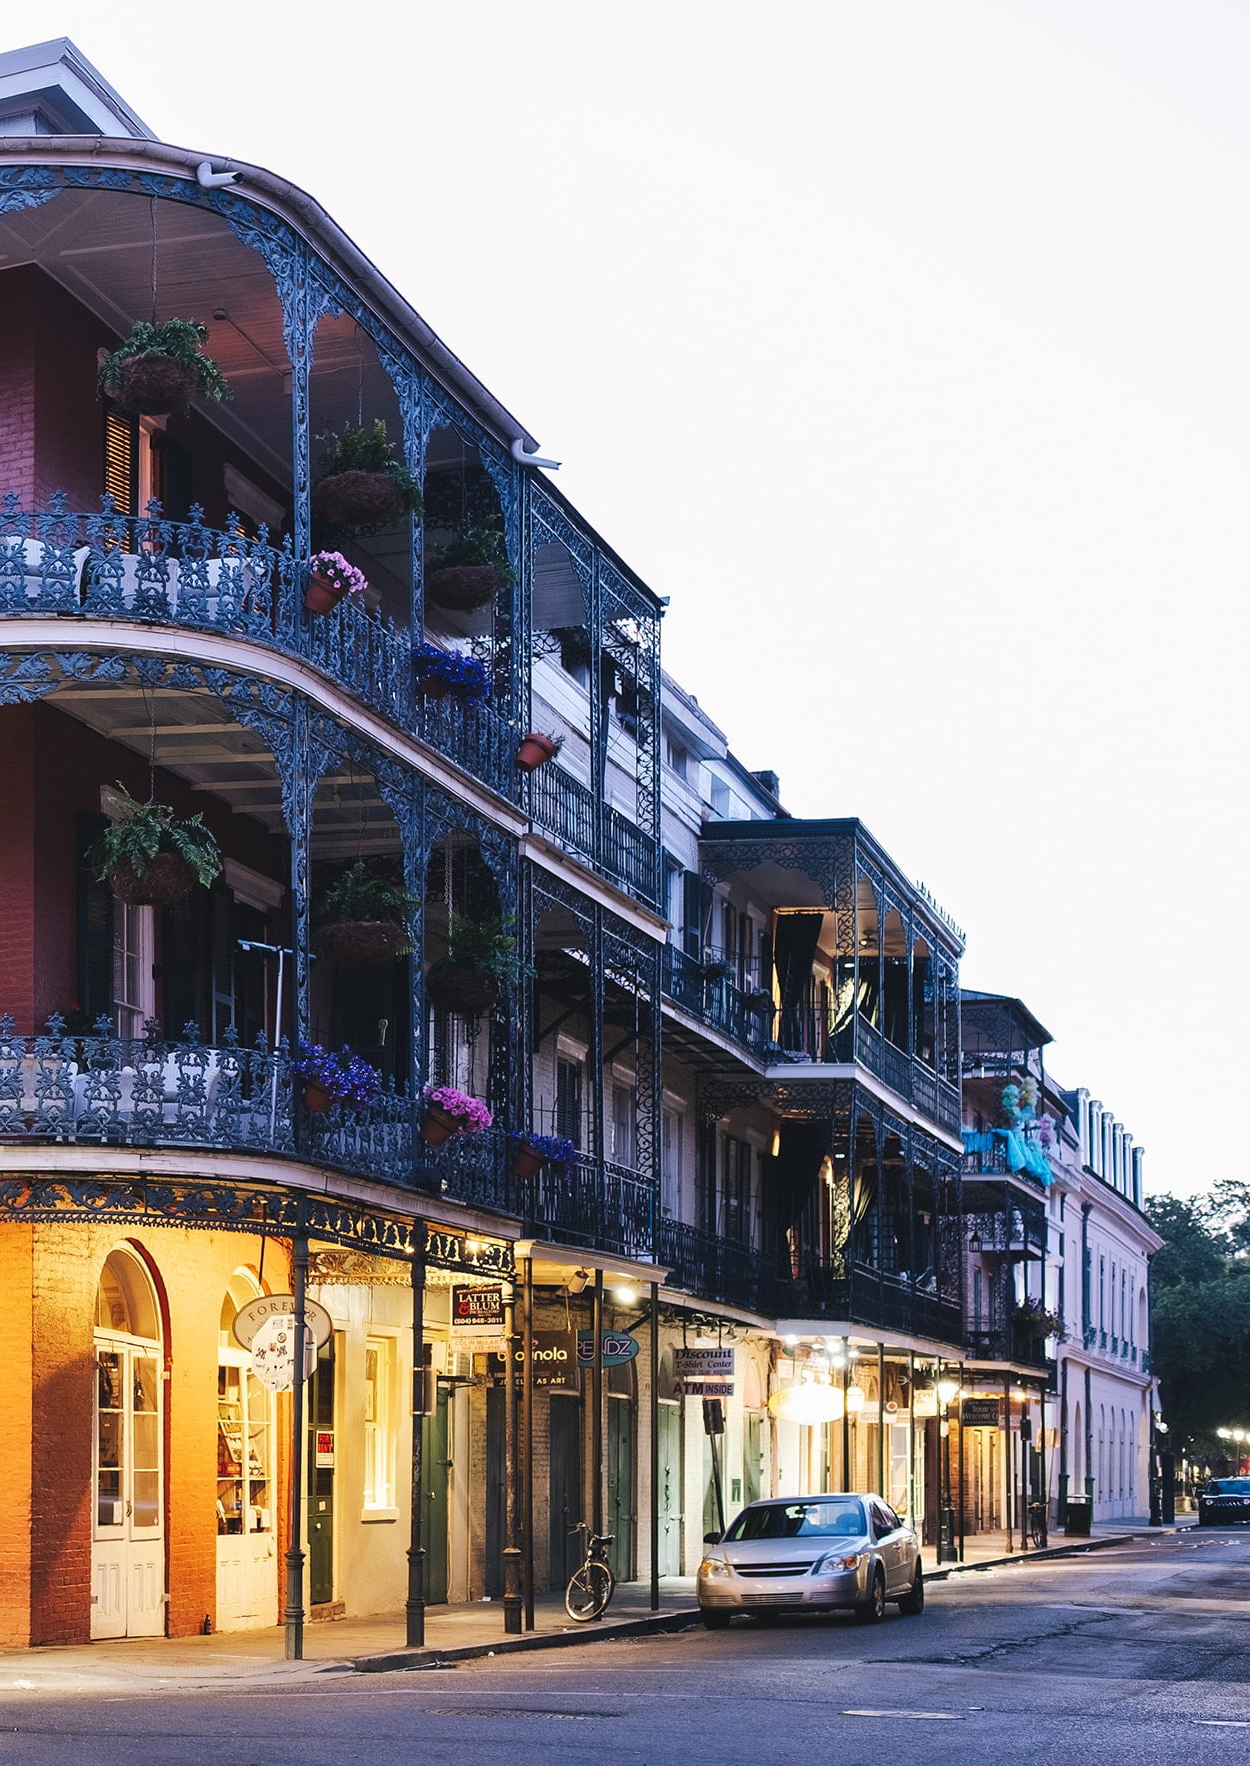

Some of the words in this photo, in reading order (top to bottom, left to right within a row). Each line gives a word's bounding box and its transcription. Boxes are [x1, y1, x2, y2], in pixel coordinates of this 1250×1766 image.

[459, 1293, 500, 1303] LATTER
[458, 1302, 470, 1316] &
[470, 1302, 500, 1311] BLUM
[675, 1349, 732, 1359] Discount
[675, 1361, 703, 1369] T-Shirt
[707, 1361, 732, 1369] Center
[550, 1377, 566, 1385] ART
[673, 1383, 703, 1394] ATM
[705, 1384, 732, 1394] INSIDE
